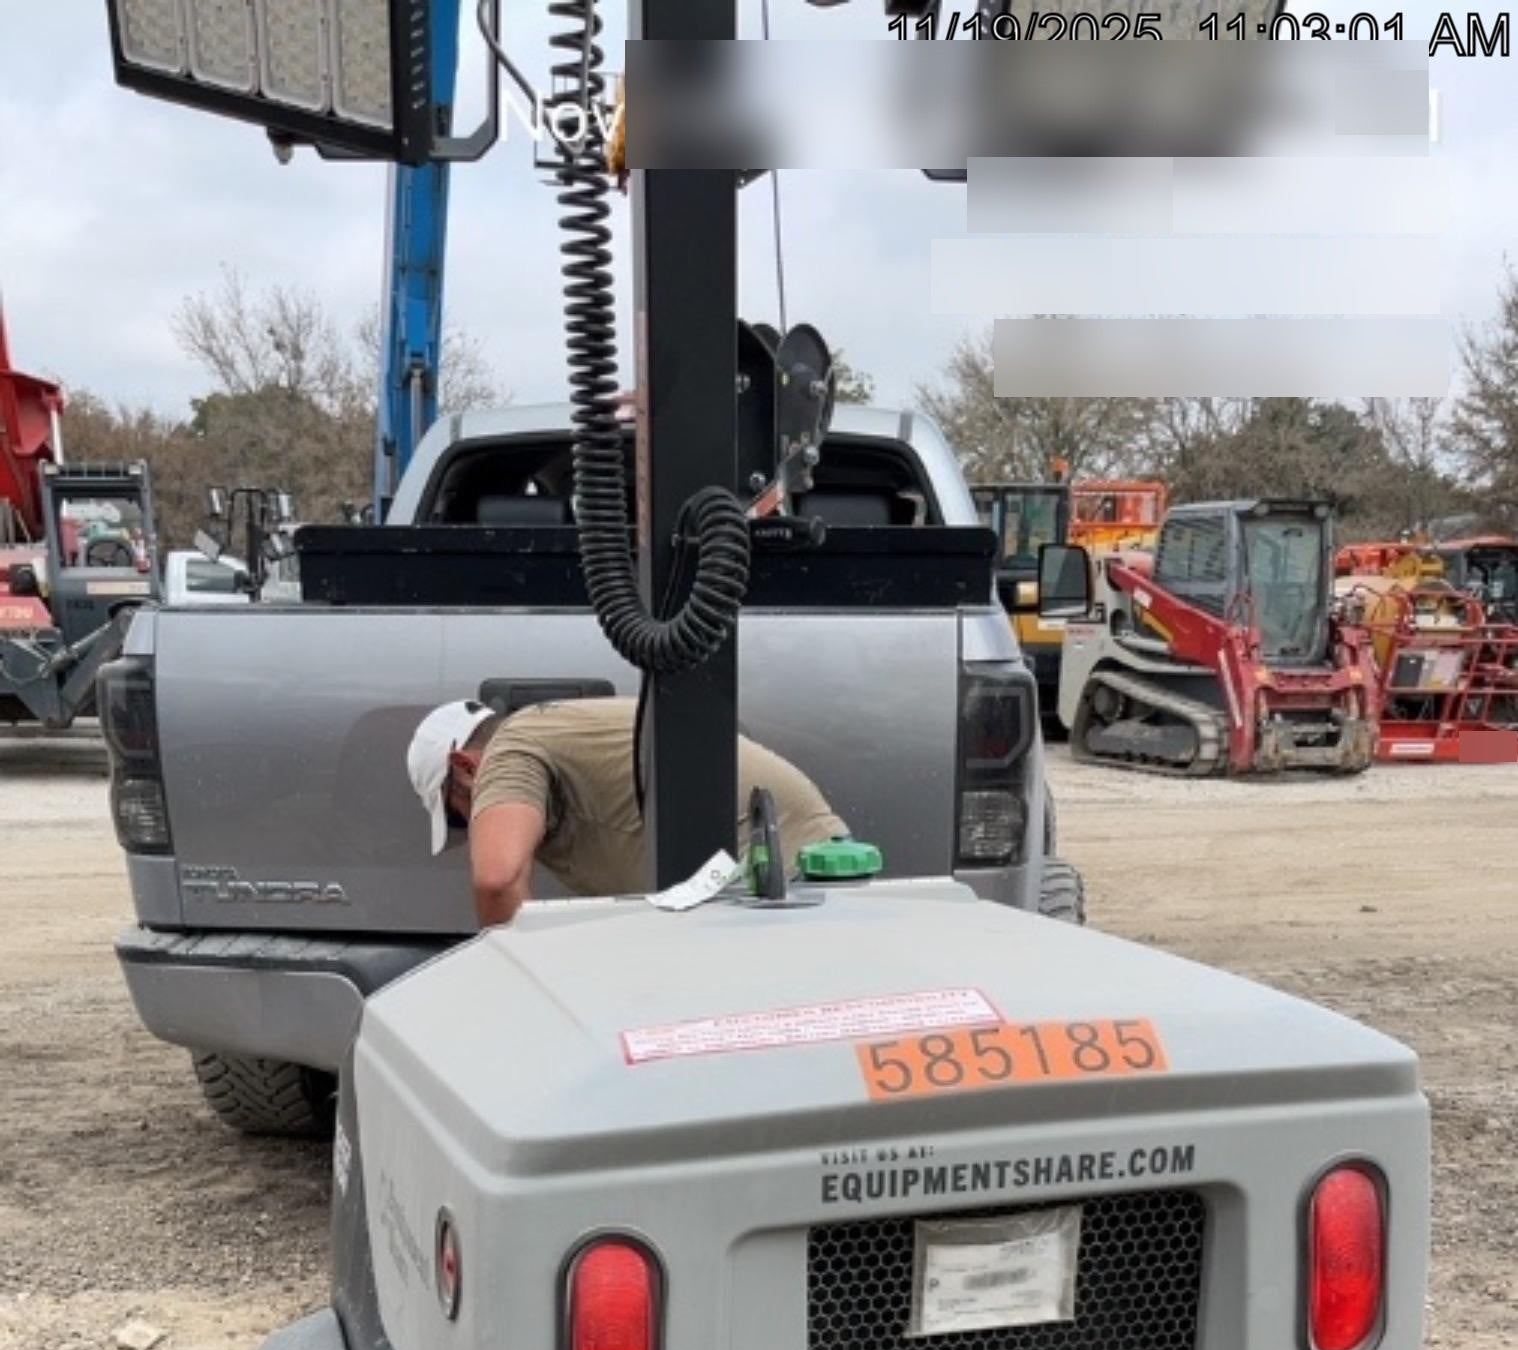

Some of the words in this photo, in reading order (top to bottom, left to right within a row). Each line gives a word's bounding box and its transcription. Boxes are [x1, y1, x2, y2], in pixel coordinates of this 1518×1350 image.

[868, 1018, 1157, 1094] 585185
[819, 1143, 1196, 1205] EQUIPMENTSHARE.COM
[820, 1148, 869, 1166] VISIT
[877, 1146, 899, 1162] US
